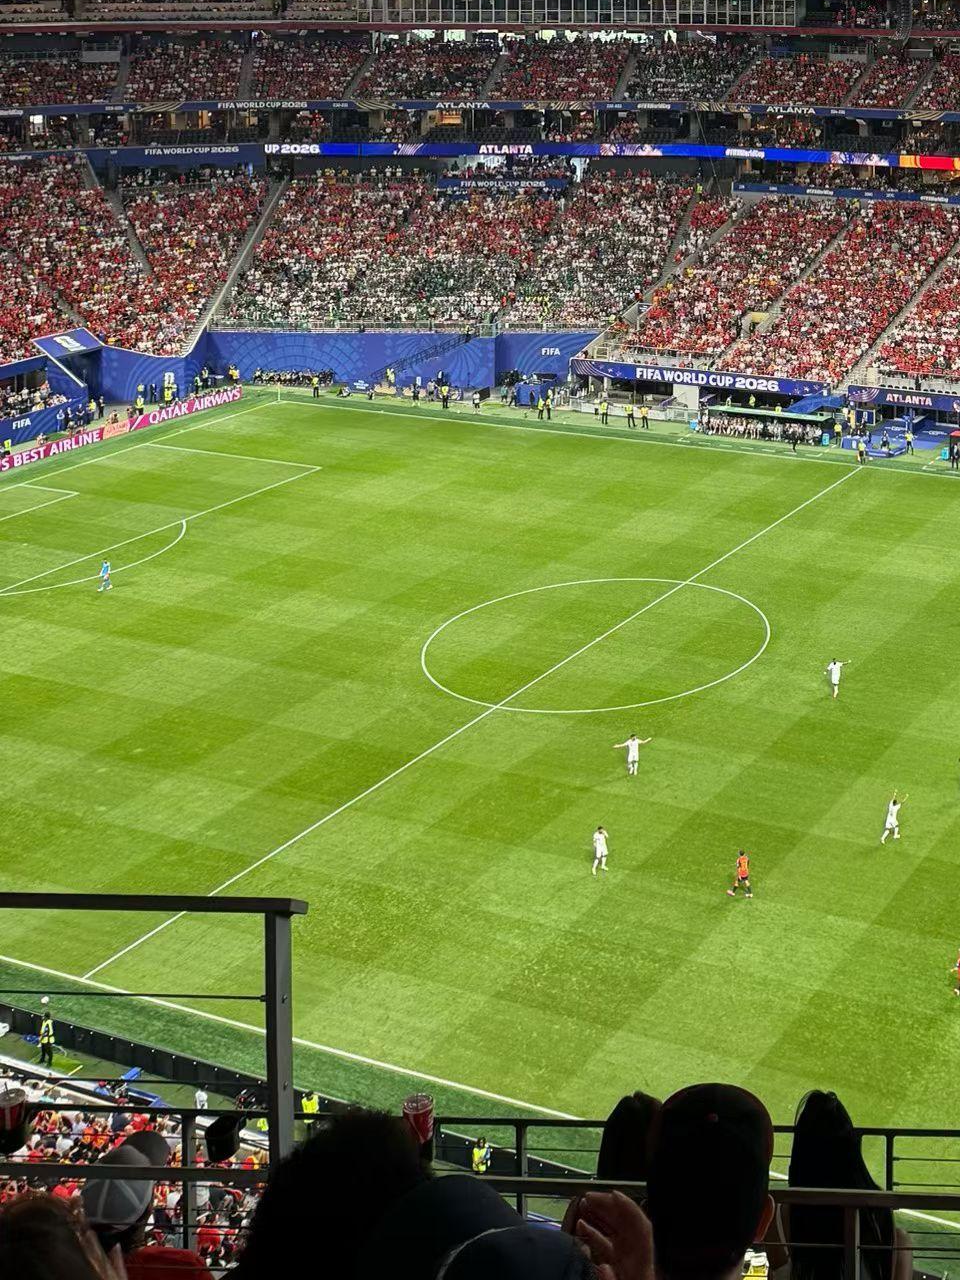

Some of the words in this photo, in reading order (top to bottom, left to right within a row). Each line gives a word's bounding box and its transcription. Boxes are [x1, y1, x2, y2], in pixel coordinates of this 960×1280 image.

[766, 105, 816, 115] ATLANTA
[163, 147, 193, 155] WORLD
[280, 144, 321, 154] 2026
[479, 144, 533, 154] ATLANTA
[541, 347, 561, 356] FIFA
[636, 367, 662, 381] FIFA
[662, 369, 707, 385] WORLD
[708, 373, 734, 387] CUP
[735, 377, 780, 392] 2026
[886, 393, 932, 407] ATLANTA
[149, 402, 190, 425] QATAR
[193, 387, 242, 414] AIRWAYS
[12, 417, 32, 430] FIFA
[13, 446, 47, 468] BEST
[49, 430, 101, 456] AIRLINE
